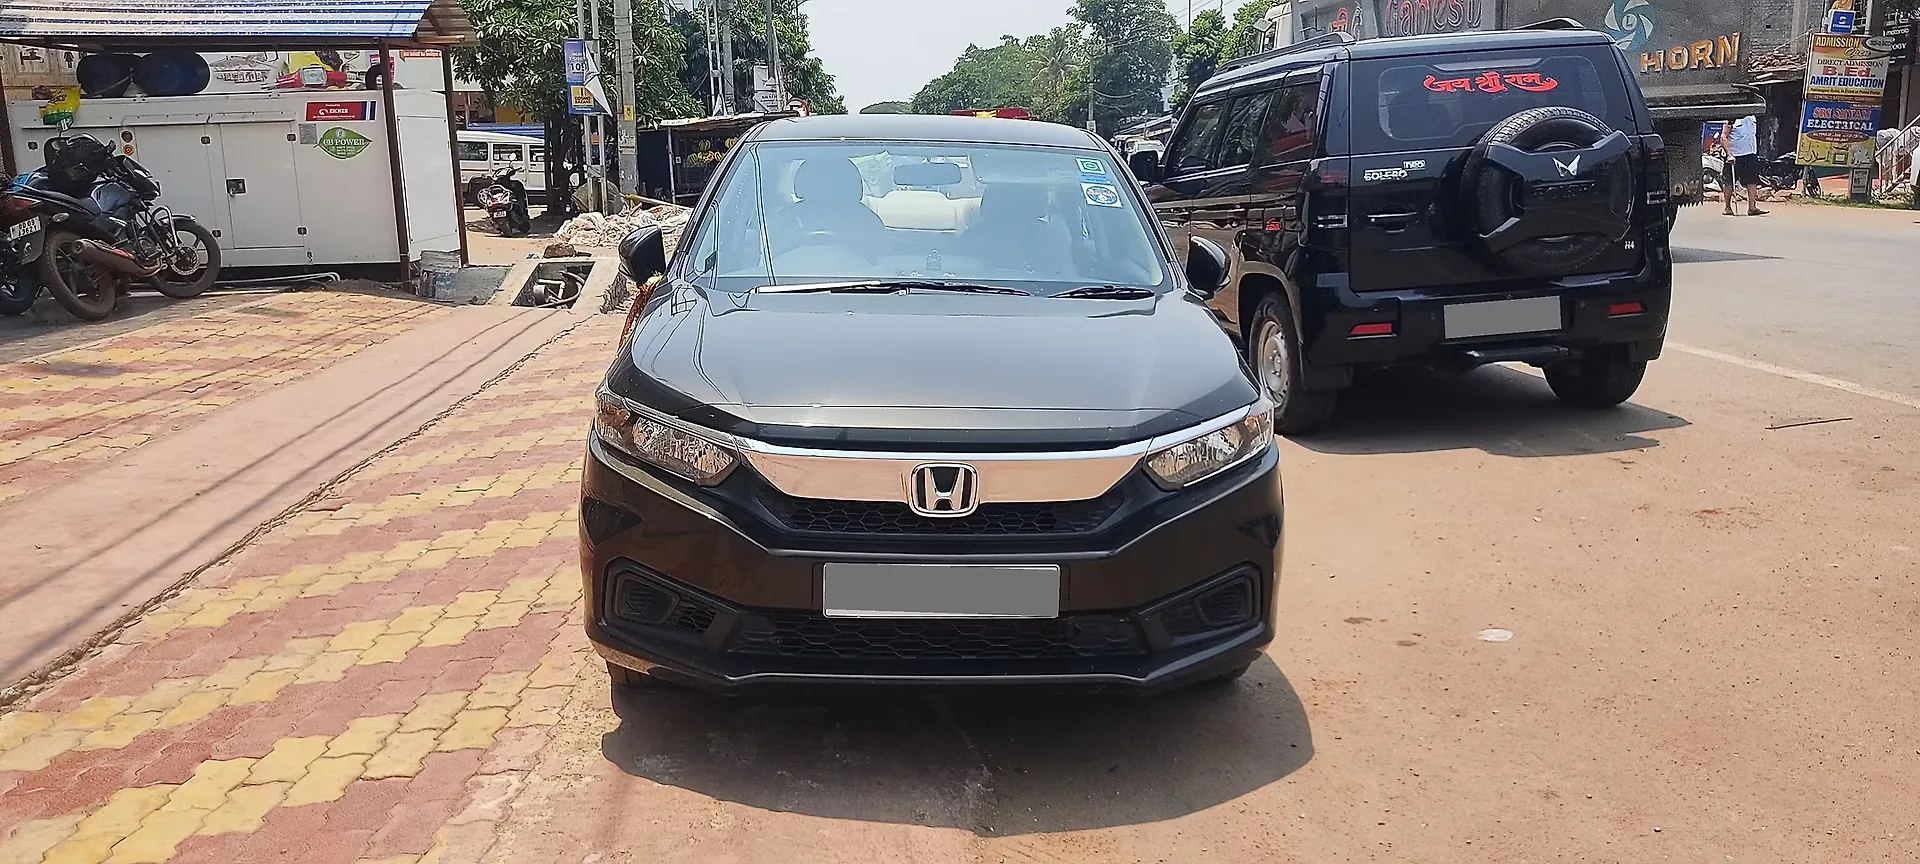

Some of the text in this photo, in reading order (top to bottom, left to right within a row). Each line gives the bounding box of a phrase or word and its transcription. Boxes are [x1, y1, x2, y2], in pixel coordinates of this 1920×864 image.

[1815, 36, 1860, 47] ADMISSION
[1640, 32, 1741, 73] HORN
[1843, 60, 1884, 68] ADMISSION
[1503, 73, 1559, 92] राम
[1810, 75, 1885, 88] AMRIT EDUCATION
[1806, 119, 1874, 131] ELECTRICAL
